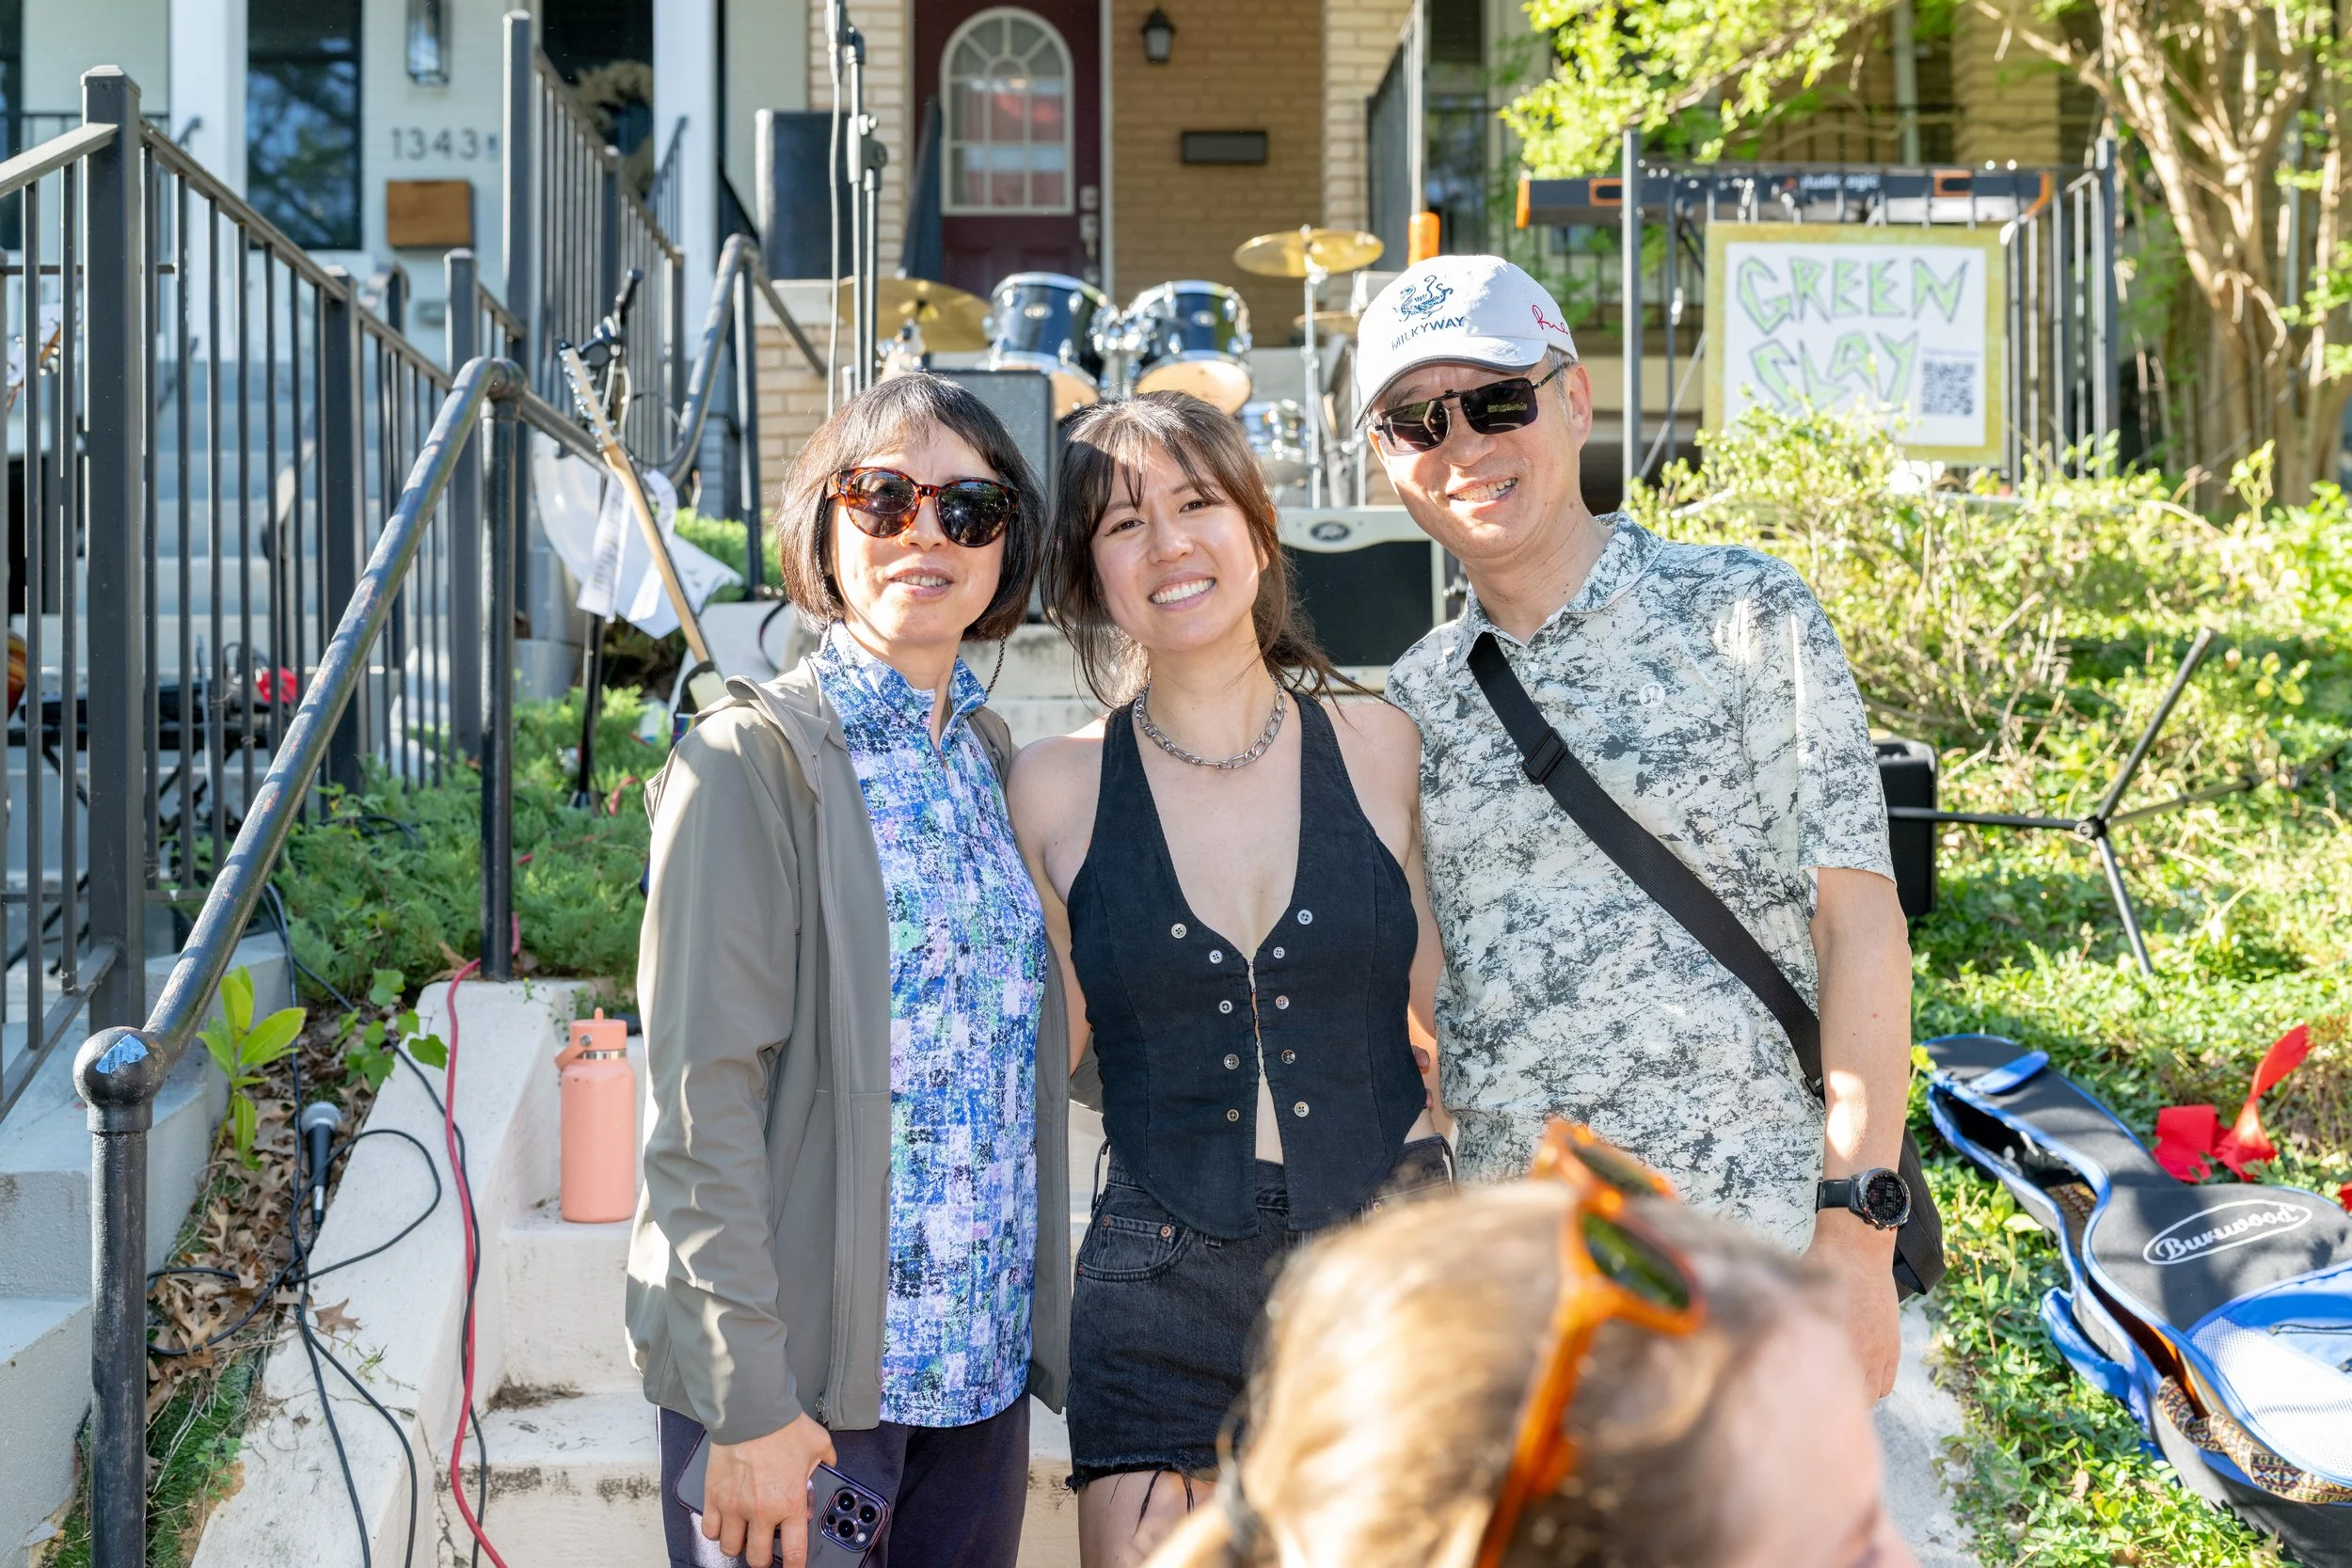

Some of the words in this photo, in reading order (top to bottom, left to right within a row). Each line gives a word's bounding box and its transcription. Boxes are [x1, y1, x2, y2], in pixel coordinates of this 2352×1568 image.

[390, 126, 480, 161] 1343
[1736, 256, 1970, 336] GREEN
[1391, 315, 1466, 351] MILKYWAY
[2154, 1205, 2299, 1260] Burwood
